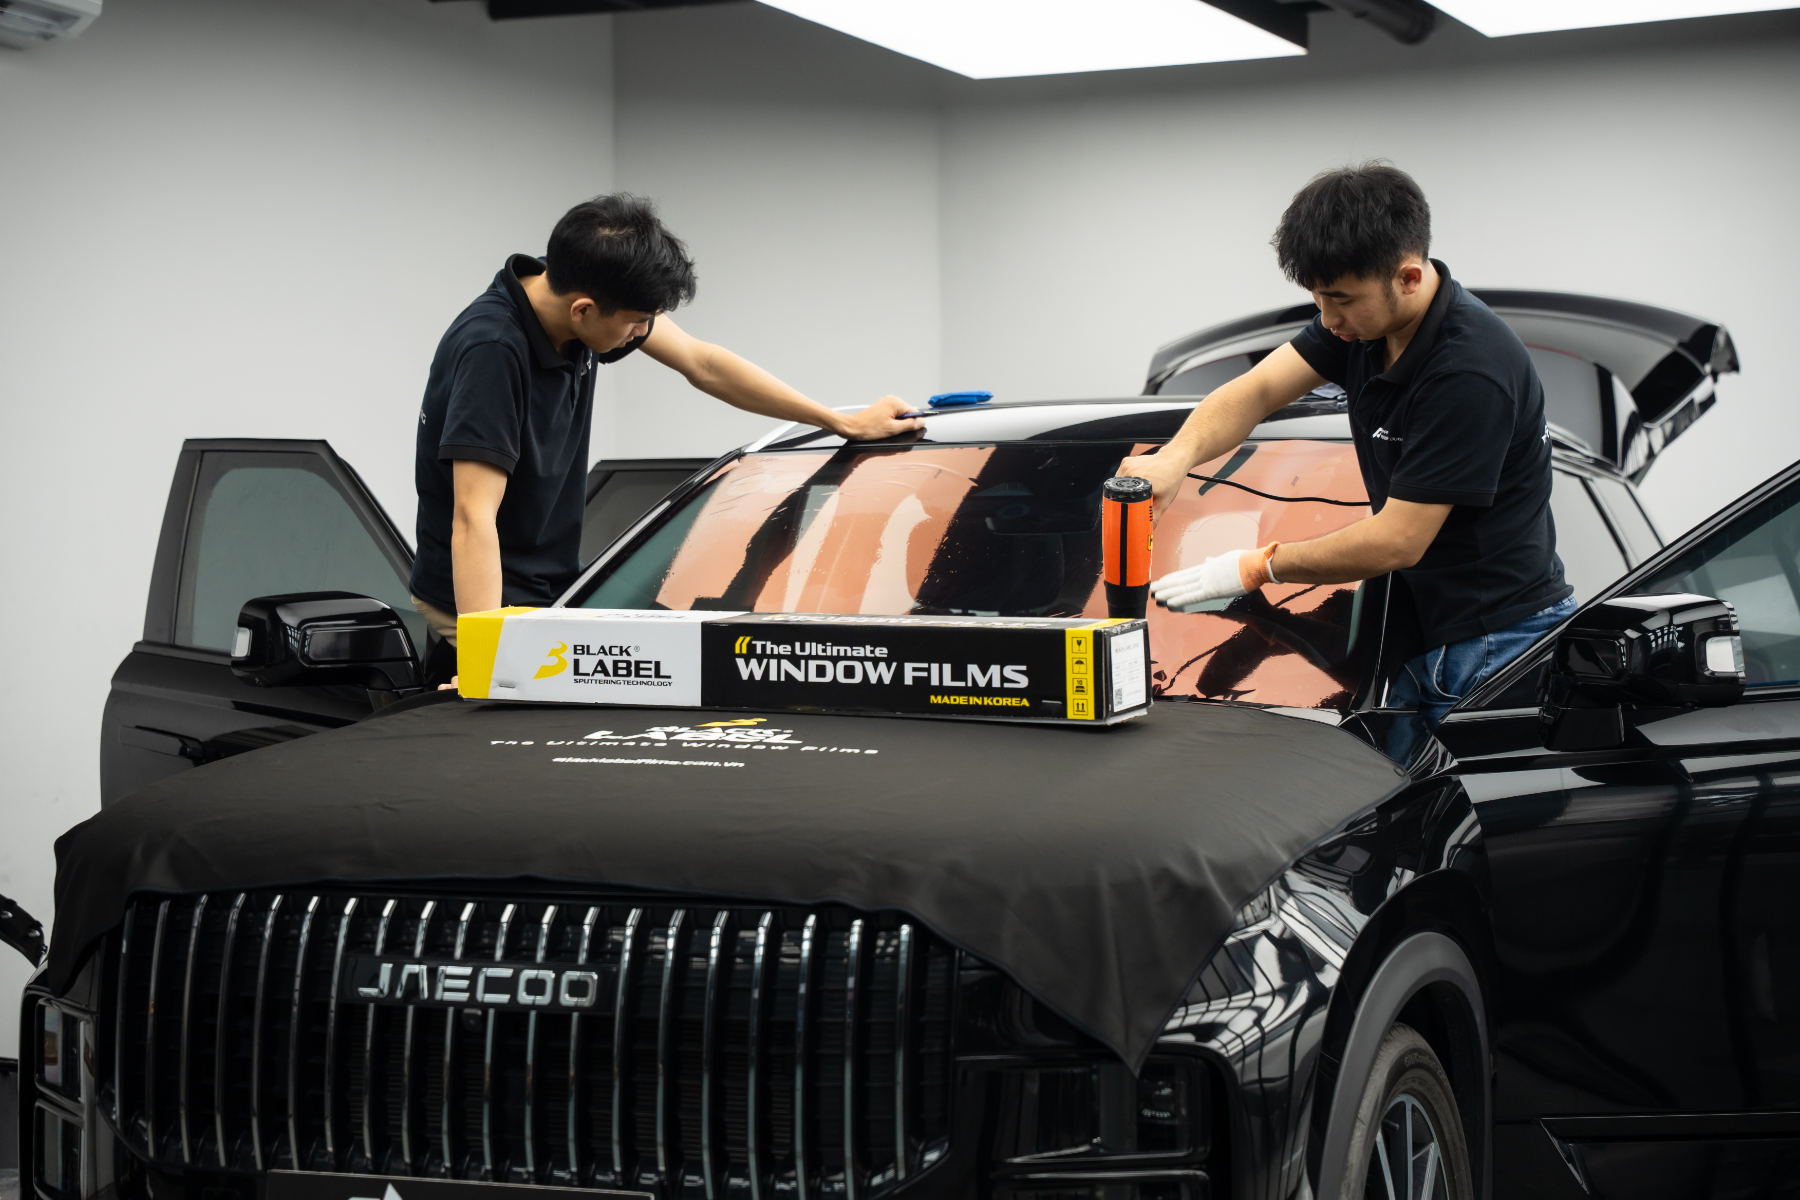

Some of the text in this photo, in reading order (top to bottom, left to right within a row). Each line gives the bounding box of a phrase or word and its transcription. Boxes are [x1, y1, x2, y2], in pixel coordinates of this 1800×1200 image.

[751, 640, 889, 658] The Ultimate
[573, 658, 672, 679] LABEL
[735, 657, 1030, 689] WINDOW FILMS
[622, 679, 673, 687] TECHNOLOGY
[929, 694, 1030, 707] MADE IN KOREA
[583, 729, 804, 744] LABEL
[681, 742, 789, 750] Window
[800, 745, 879, 755] Films
[357, 963, 598, 1008] JAECOO
